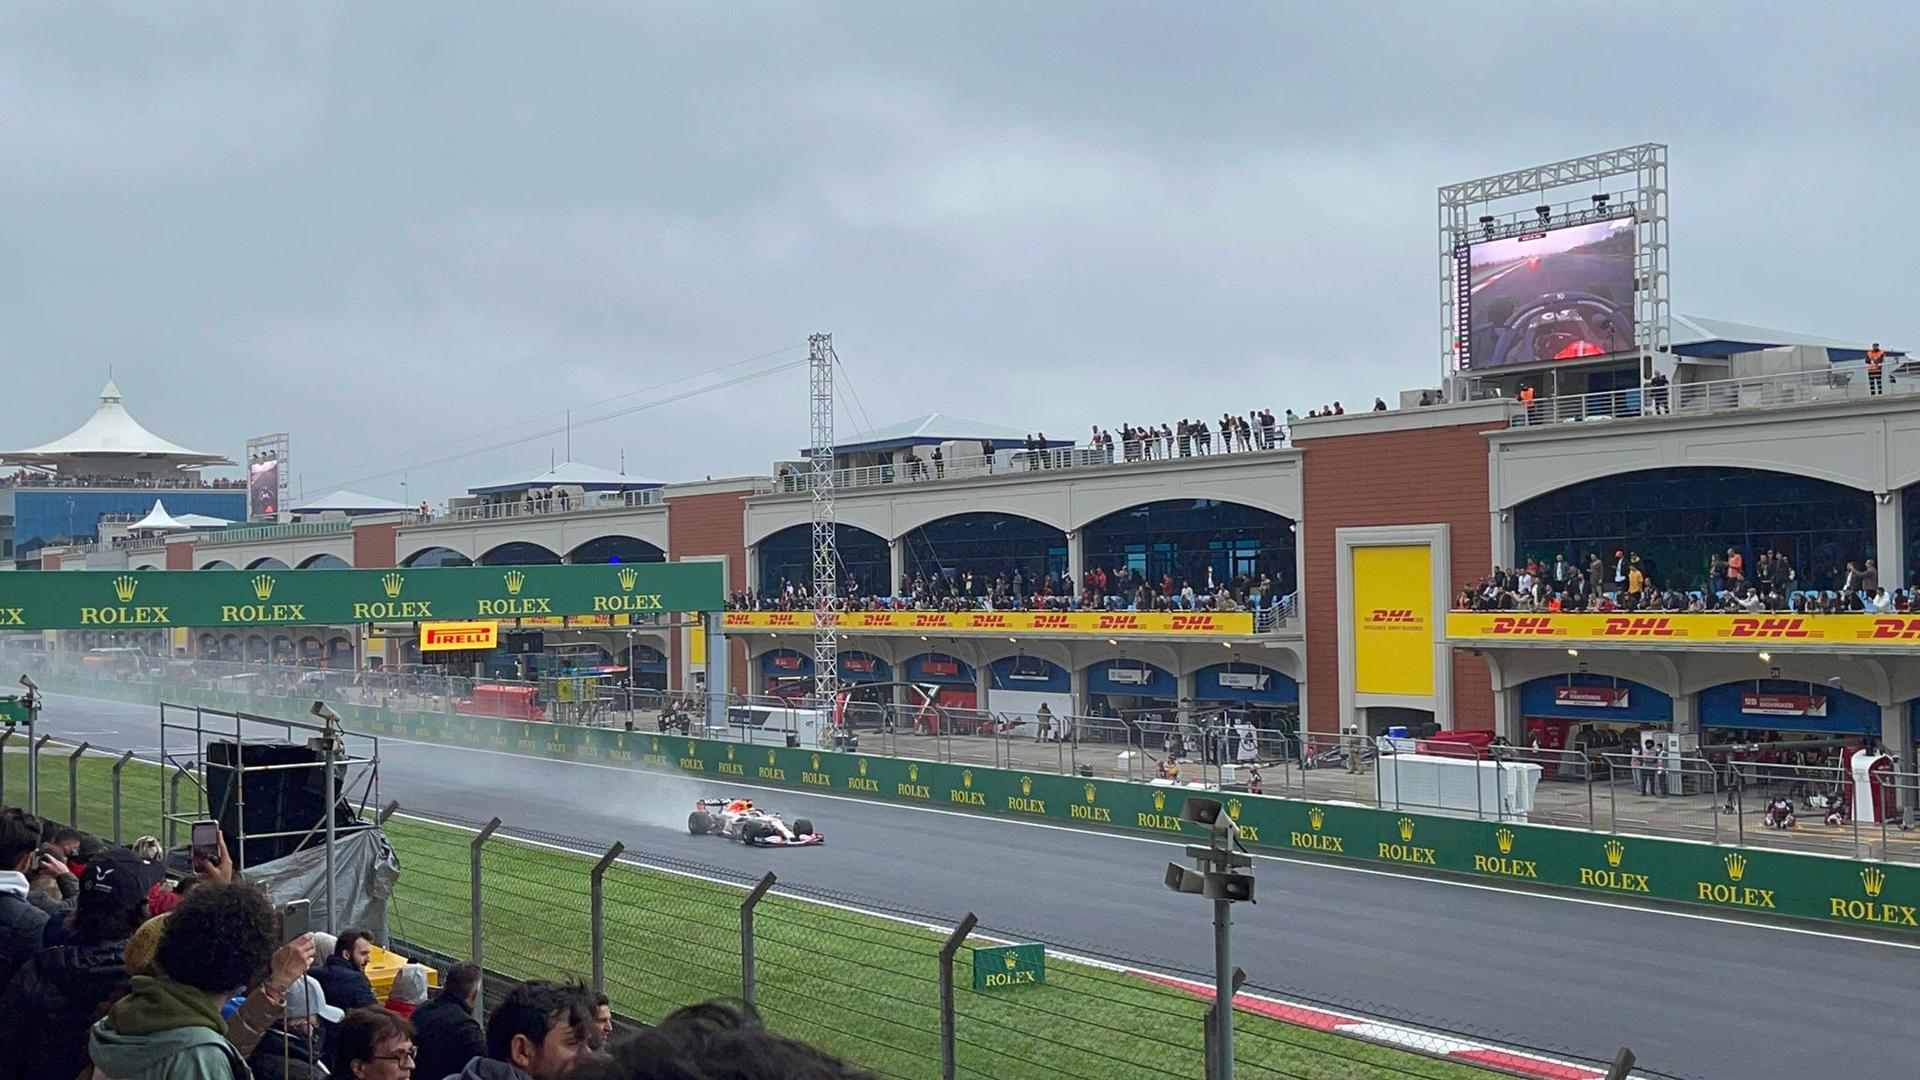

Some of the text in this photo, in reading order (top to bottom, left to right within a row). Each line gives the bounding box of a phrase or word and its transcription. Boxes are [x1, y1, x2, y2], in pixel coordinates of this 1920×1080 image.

[354, 602, 432, 618] ROLEX
[478, 598, 551, 614] ROLEX
[593, 595, 663, 611] ROLEX
[81, 607, 170, 624] ROLEX
[222, 605, 305, 621] ROLEX
[727, 615, 750, 625] DHL
[769, 615, 795, 626] DHL
[864, 615, 892, 626] DHL
[916, 615, 948, 627] DHL
[1373, 610, 1415, 622] DHL
[973, 615, 1006, 628] DHL
[1033, 615, 1070, 629] DHL
[1099, 616, 1139, 630] DHL
[1171, 616, 1215, 631] DHL
[1493, 617, 1556, 635] DHL
[1605, 618, 1675, 636] DHL
[1731, 618, 1809, 638] DHL
[427, 628, 490, 644] PIRELLI
[680, 758, 704, 770] ROLEX
[719, 761, 744, 775] ROLEX
[759, 766, 785, 781] ROLEX
[803, 771, 830, 786] ROLEX
[849, 776, 879, 792] ROLEX
[898, 783, 930, 799] ROLEX
[951, 789, 985, 806] ROLEX
[1008, 797, 1046, 814] ROLEX
[1071, 804, 1111, 822] ROLEX
[1138, 812, 1182, 832] ROLEX
[1291, 831, 1343, 852] ROLEX
[1378, 842, 1437, 865] ROLEX
[1474, 854, 1538, 878] ROLEX
[1580, 868, 1650, 893] ROLEX
[1697, 881, 1776, 908] ROLEX
[1830, 897, 1918, 926] ROLEX
[986, 971, 1035, 986] ROLEX
